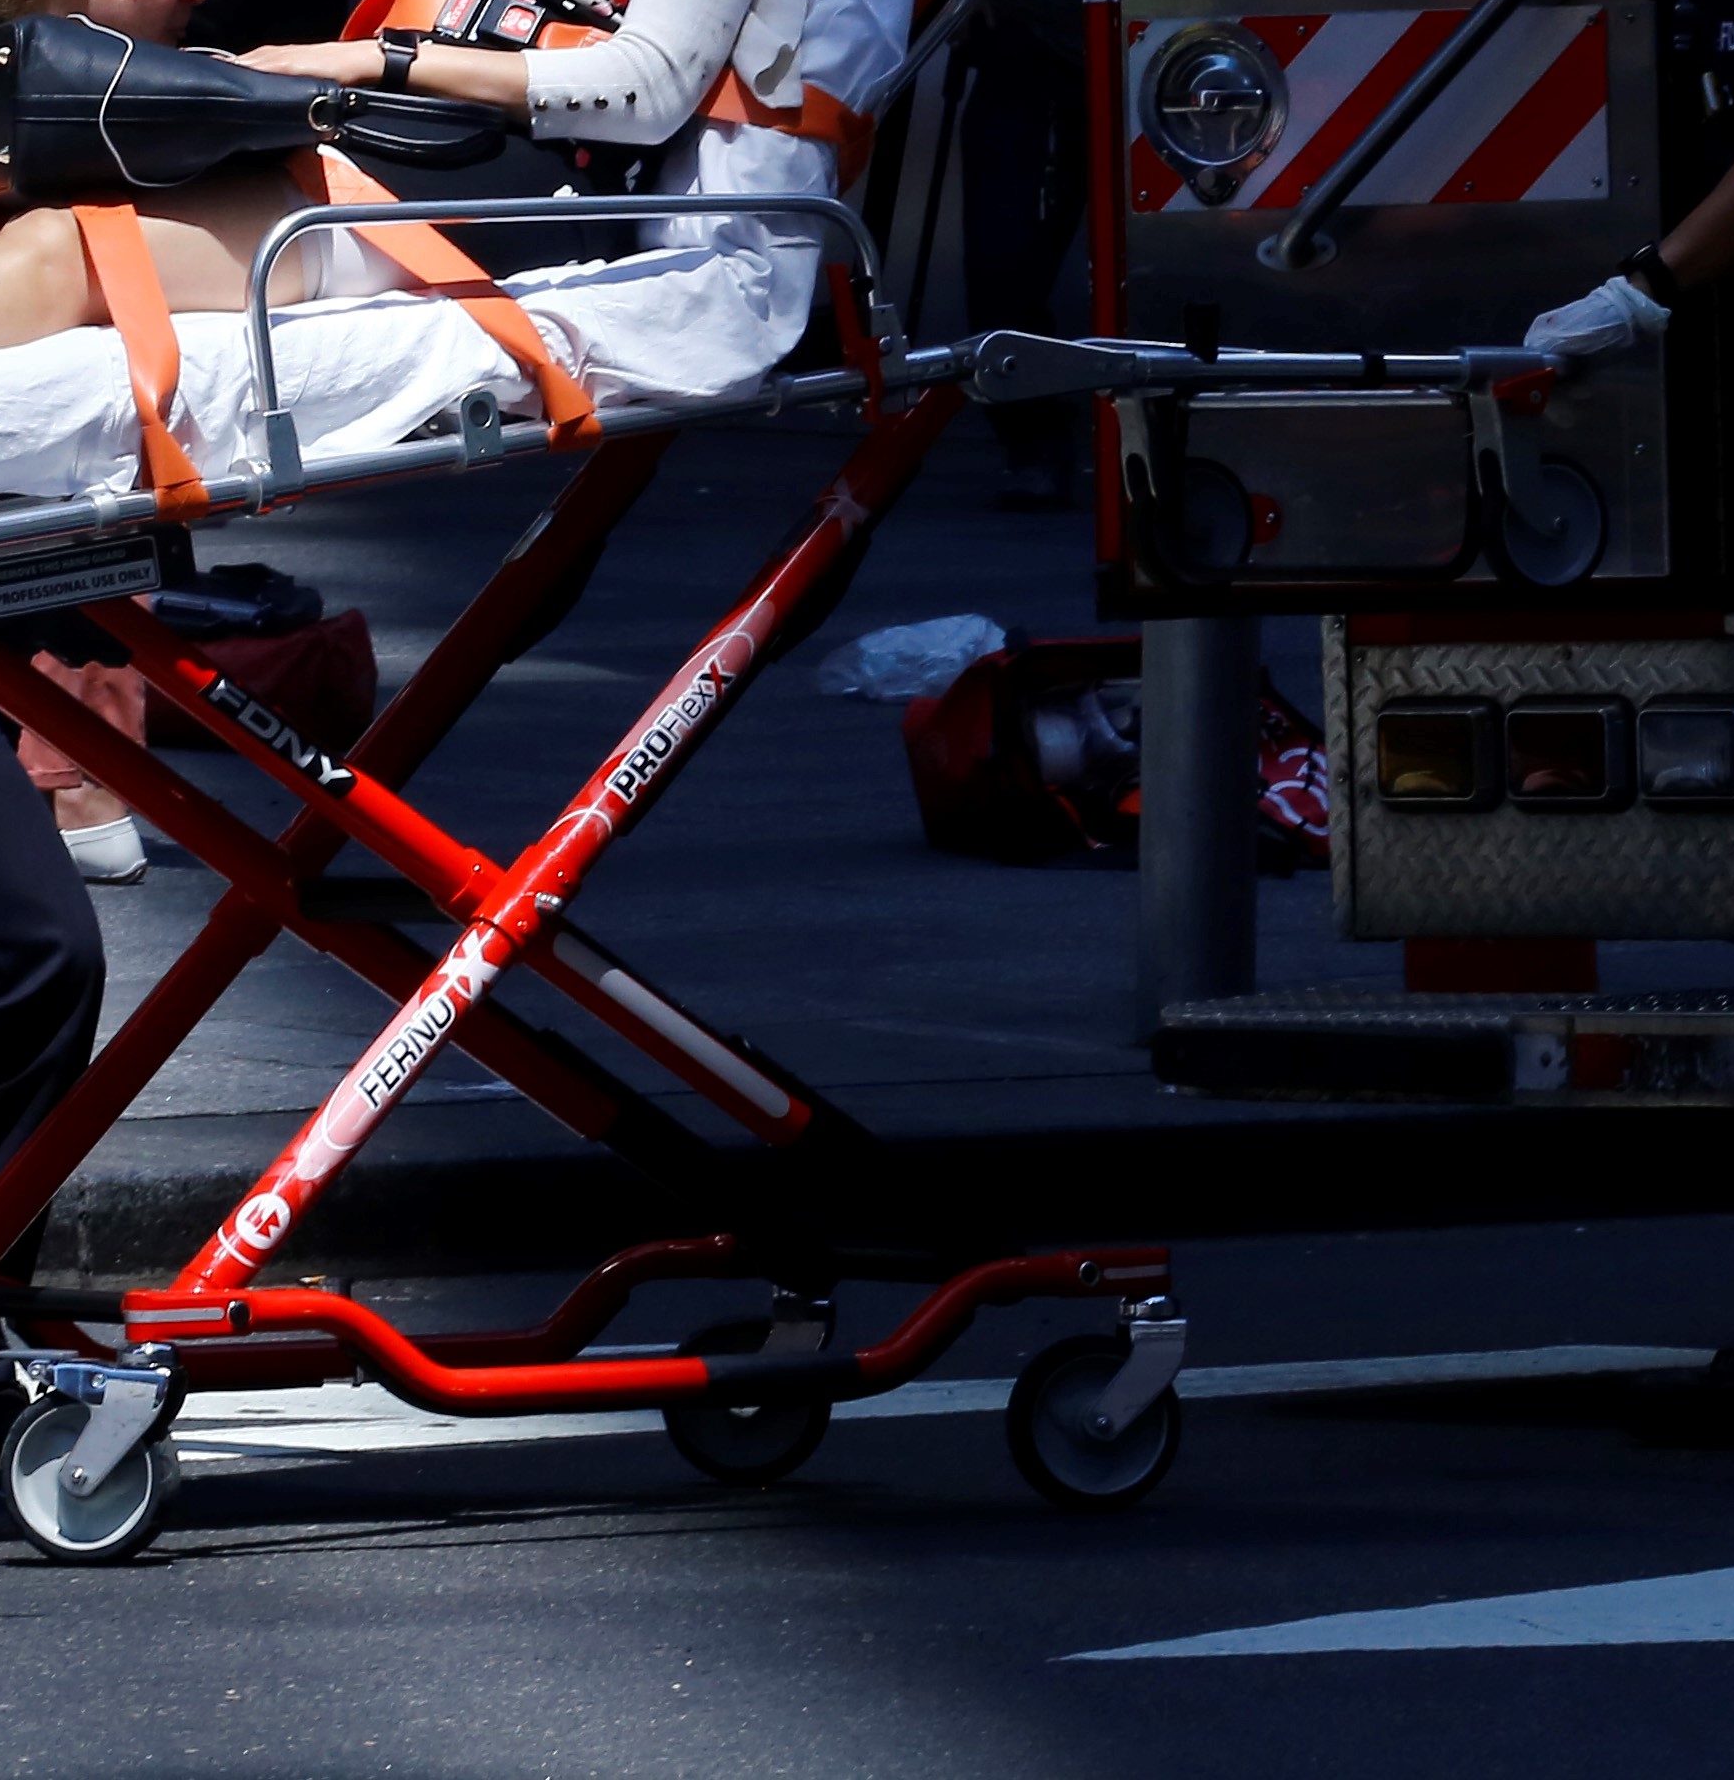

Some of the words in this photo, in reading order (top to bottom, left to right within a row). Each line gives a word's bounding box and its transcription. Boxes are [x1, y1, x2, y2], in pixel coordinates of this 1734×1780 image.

[92, 573, 116, 588] USE
[118, 565, 152, 583] ONLY
[208, 677, 354, 786] FDNY
